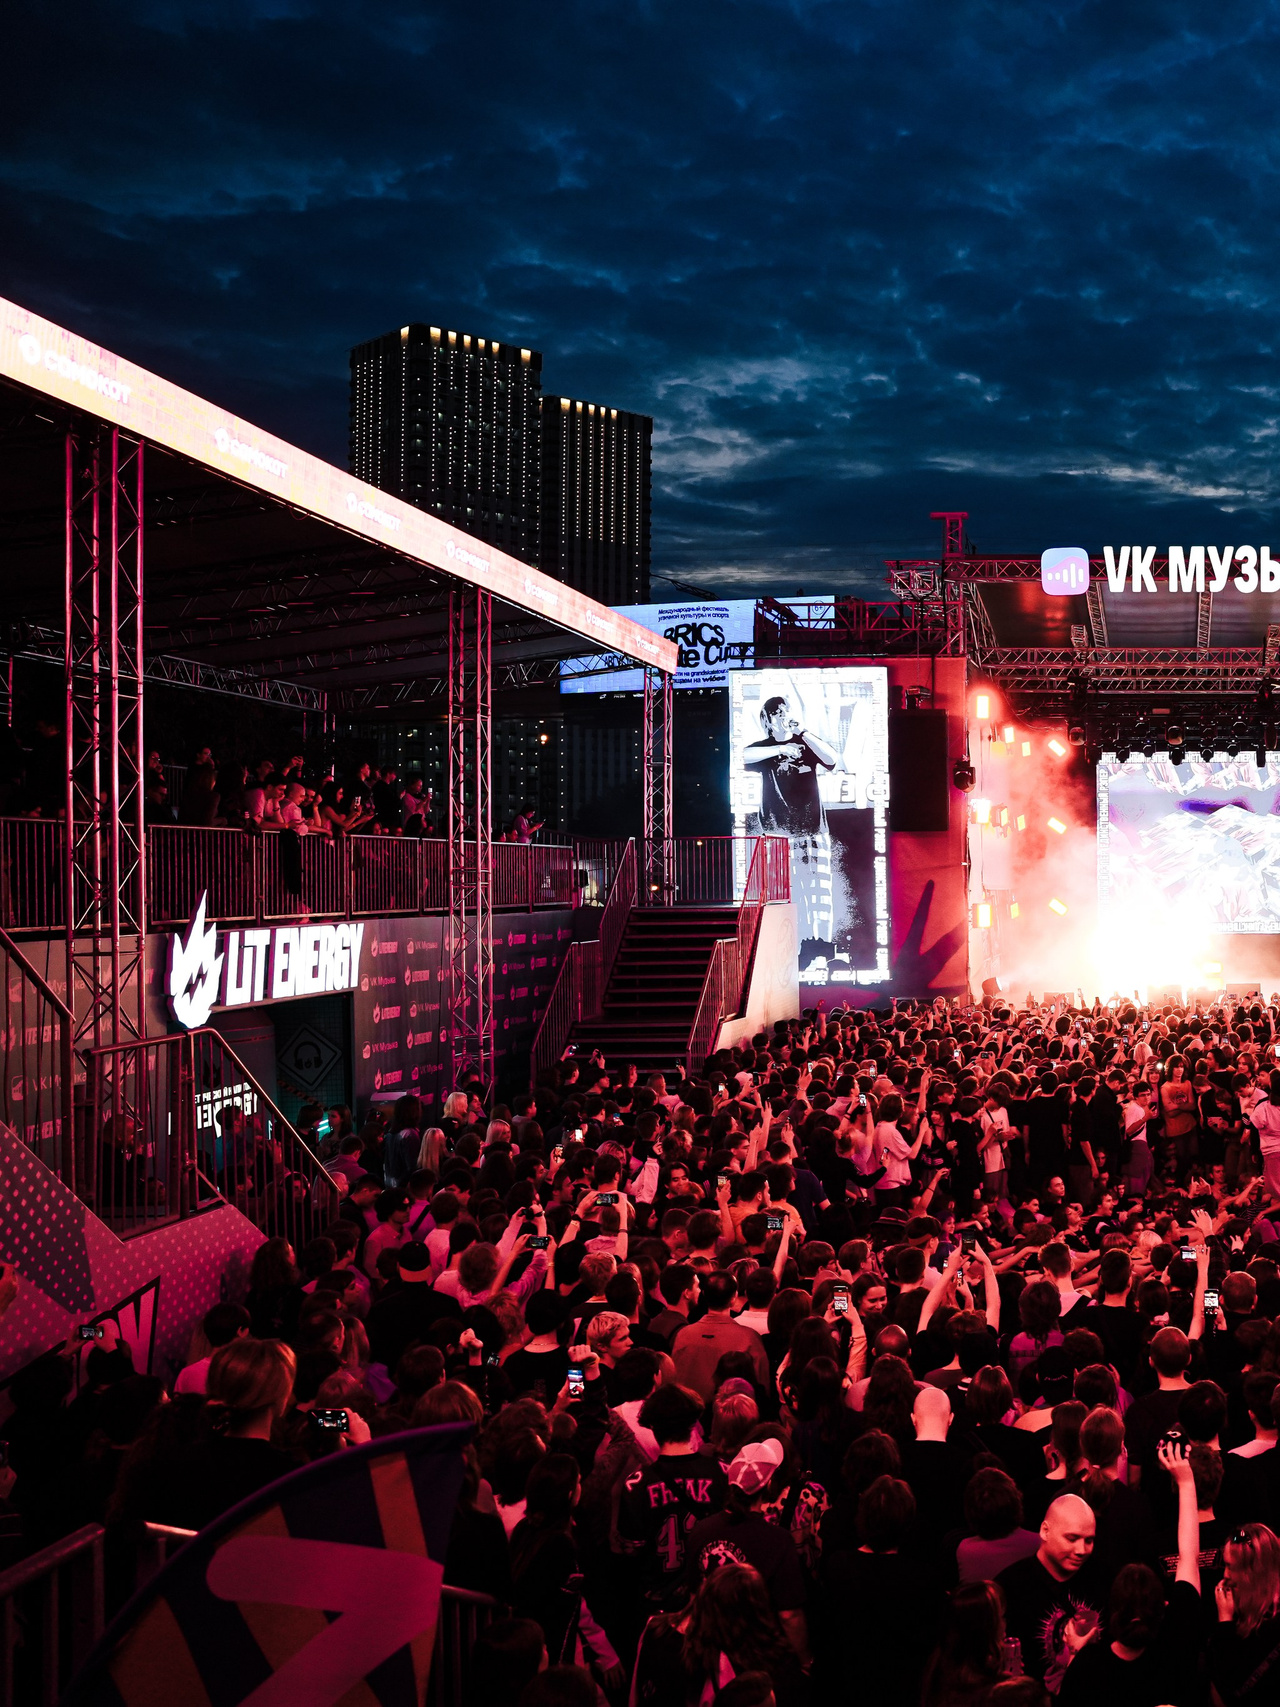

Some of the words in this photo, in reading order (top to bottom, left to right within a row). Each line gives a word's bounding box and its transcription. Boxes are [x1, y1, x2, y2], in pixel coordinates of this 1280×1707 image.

[1102, 545, 1158, 593] VK
[226, 929, 271, 1007] LIT
[272, 922, 365, 999] ENERGY
